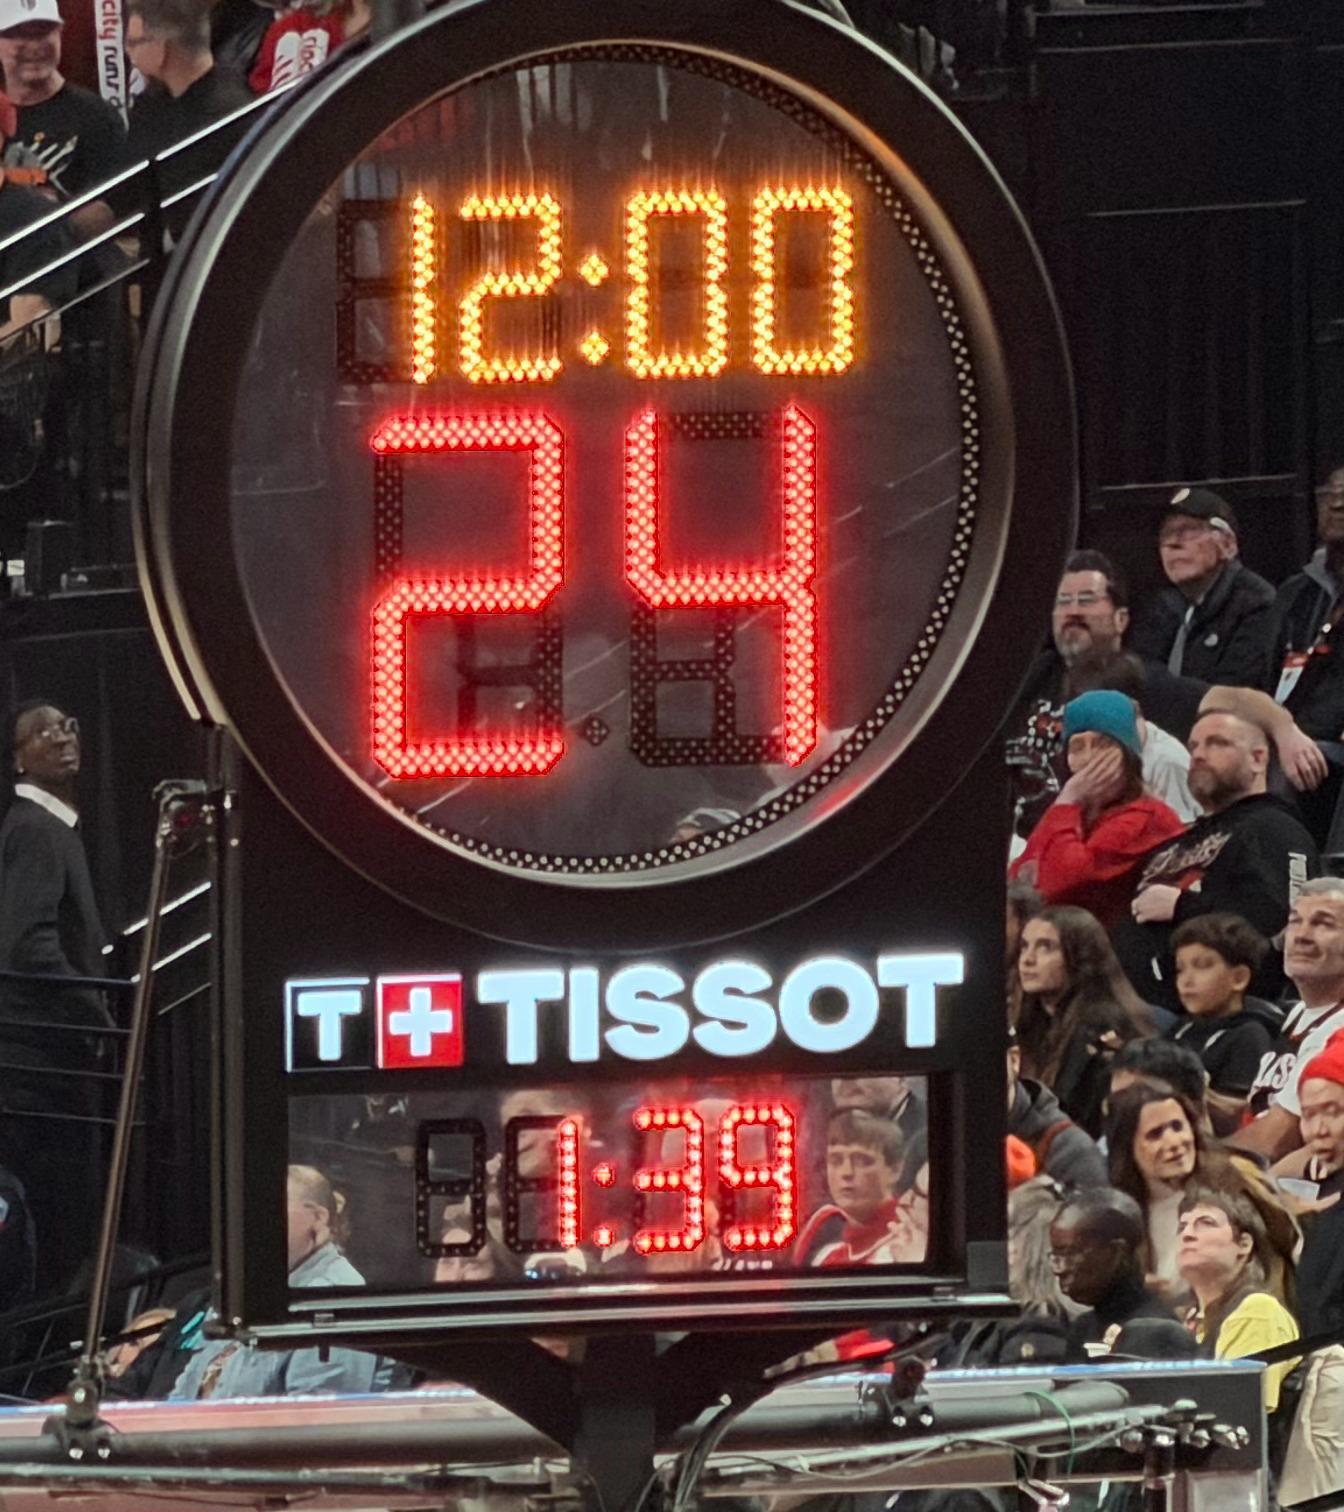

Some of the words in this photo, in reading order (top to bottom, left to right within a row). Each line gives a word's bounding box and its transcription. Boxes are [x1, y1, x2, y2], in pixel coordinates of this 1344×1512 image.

[412, 190, 853, 384] 12:00
[372, 405, 817, 779] 24
[477, 951, 965, 1065] TISSOT
[560, 1104, 797, 1255] 1:39
